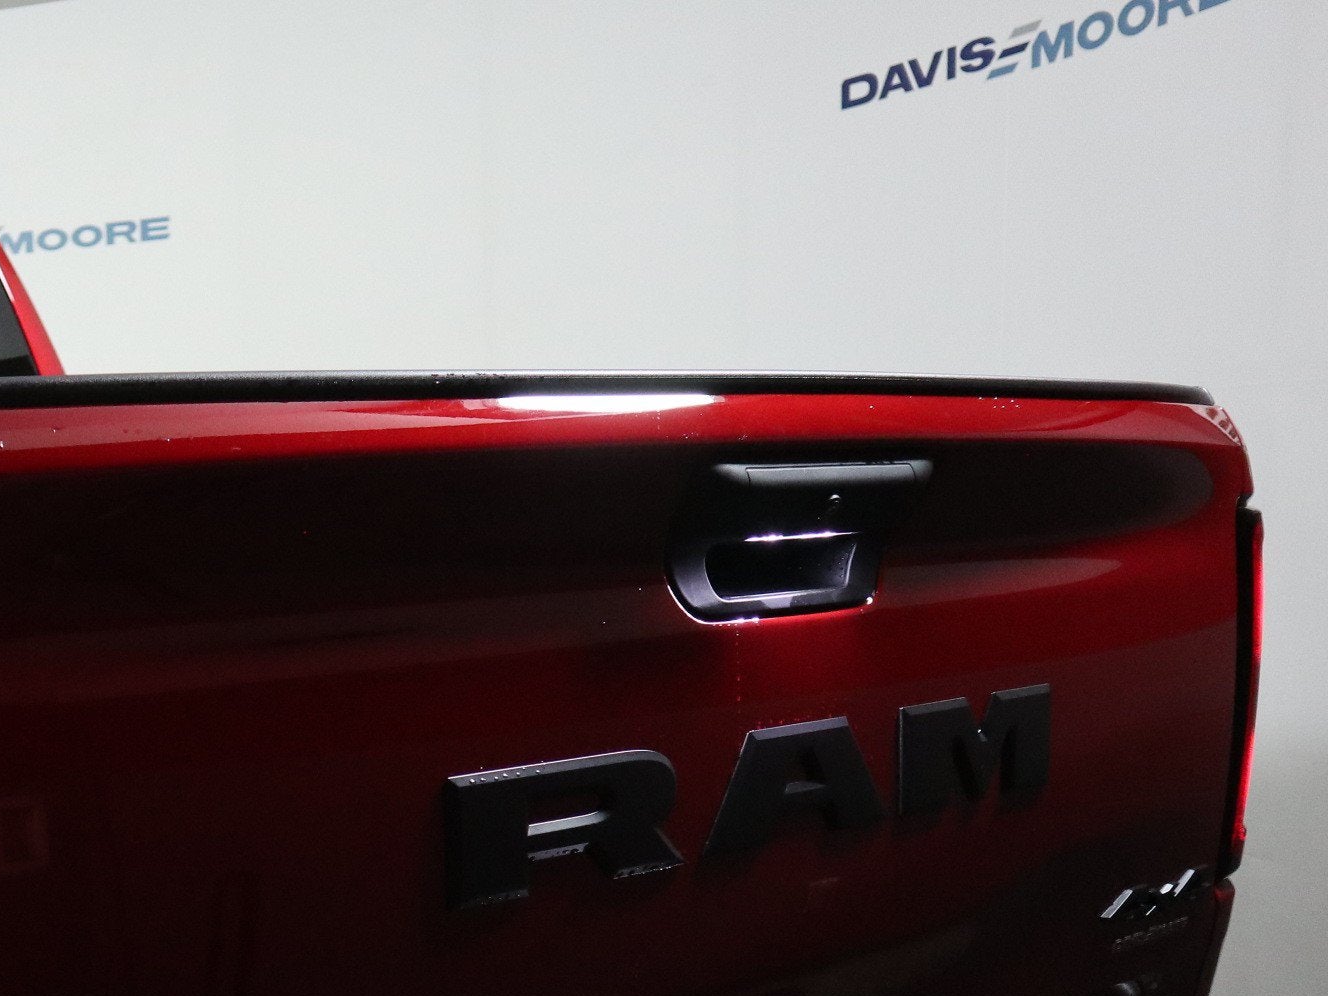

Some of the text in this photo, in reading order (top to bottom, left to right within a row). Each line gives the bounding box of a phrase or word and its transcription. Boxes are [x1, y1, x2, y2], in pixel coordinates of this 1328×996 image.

[840, 36, 996, 110] DAVIS
[0, 216, 170, 254] MOORE
[444, 683, 1052, 908] RAM
